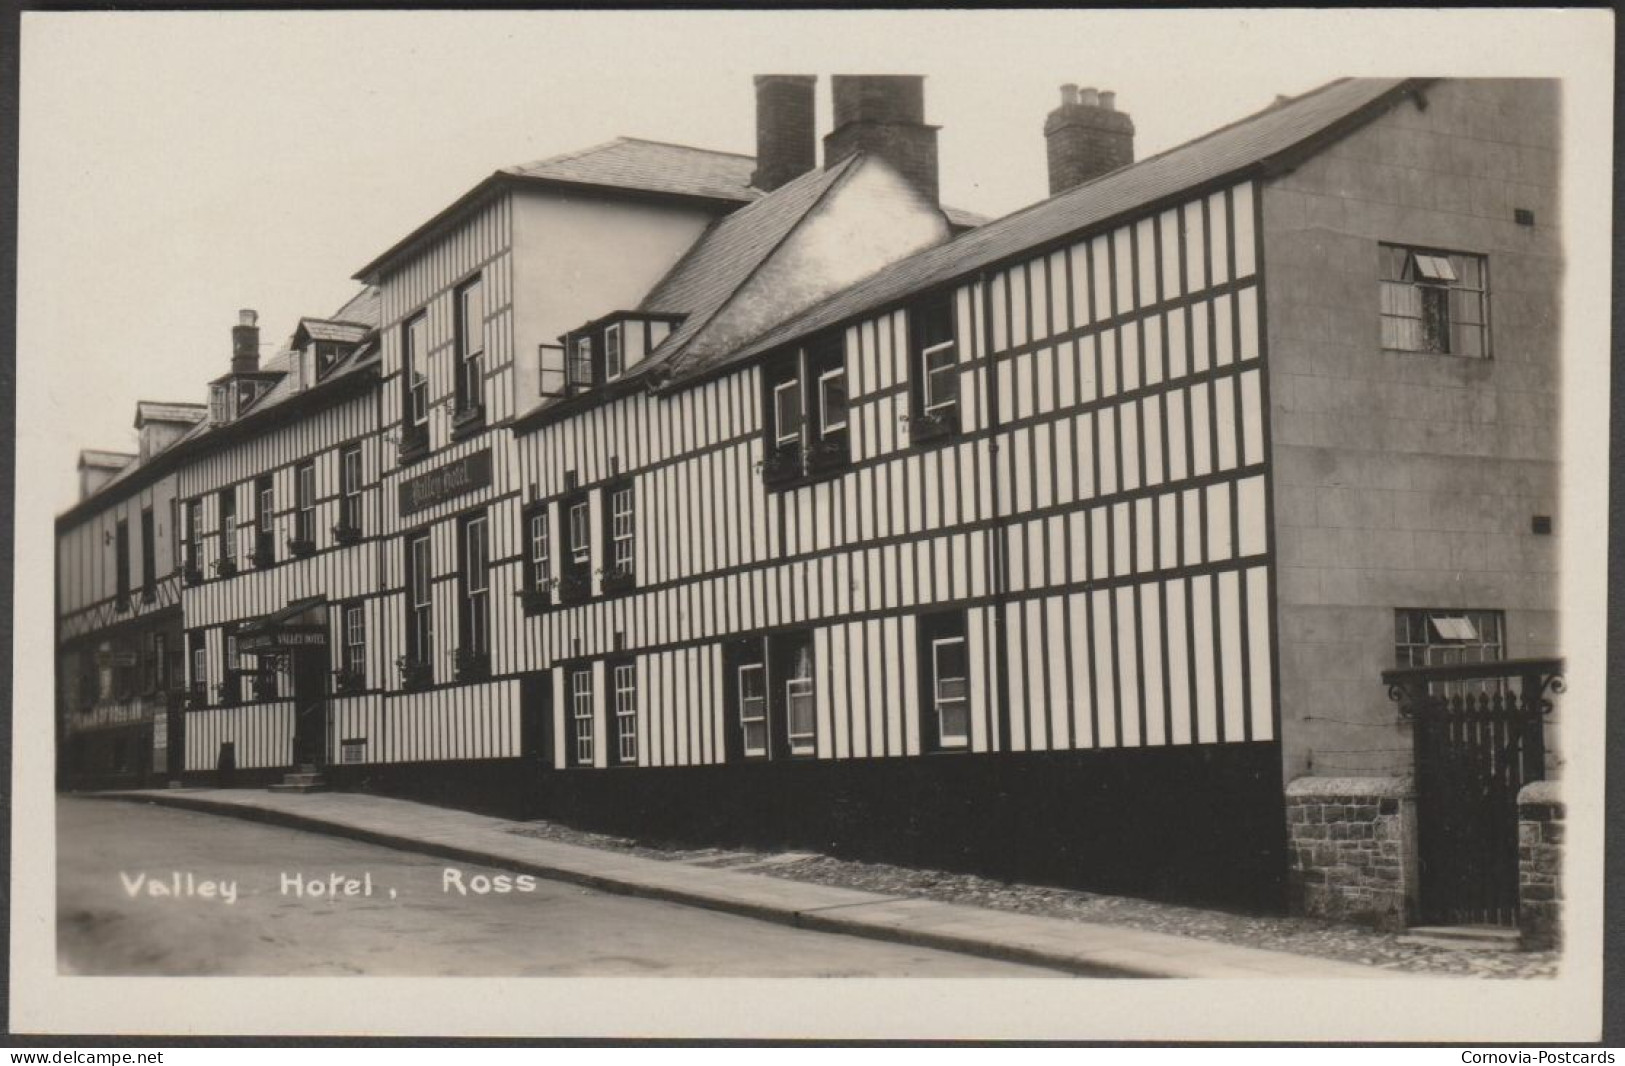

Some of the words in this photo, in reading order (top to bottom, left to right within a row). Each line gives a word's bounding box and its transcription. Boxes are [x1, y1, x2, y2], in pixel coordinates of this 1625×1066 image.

[277, 632, 303, 645] VALLEY
[304, 632, 326, 645] HOTEL
[119, 870, 238, 905] Valley
[442, 868, 537, 897] Ross
